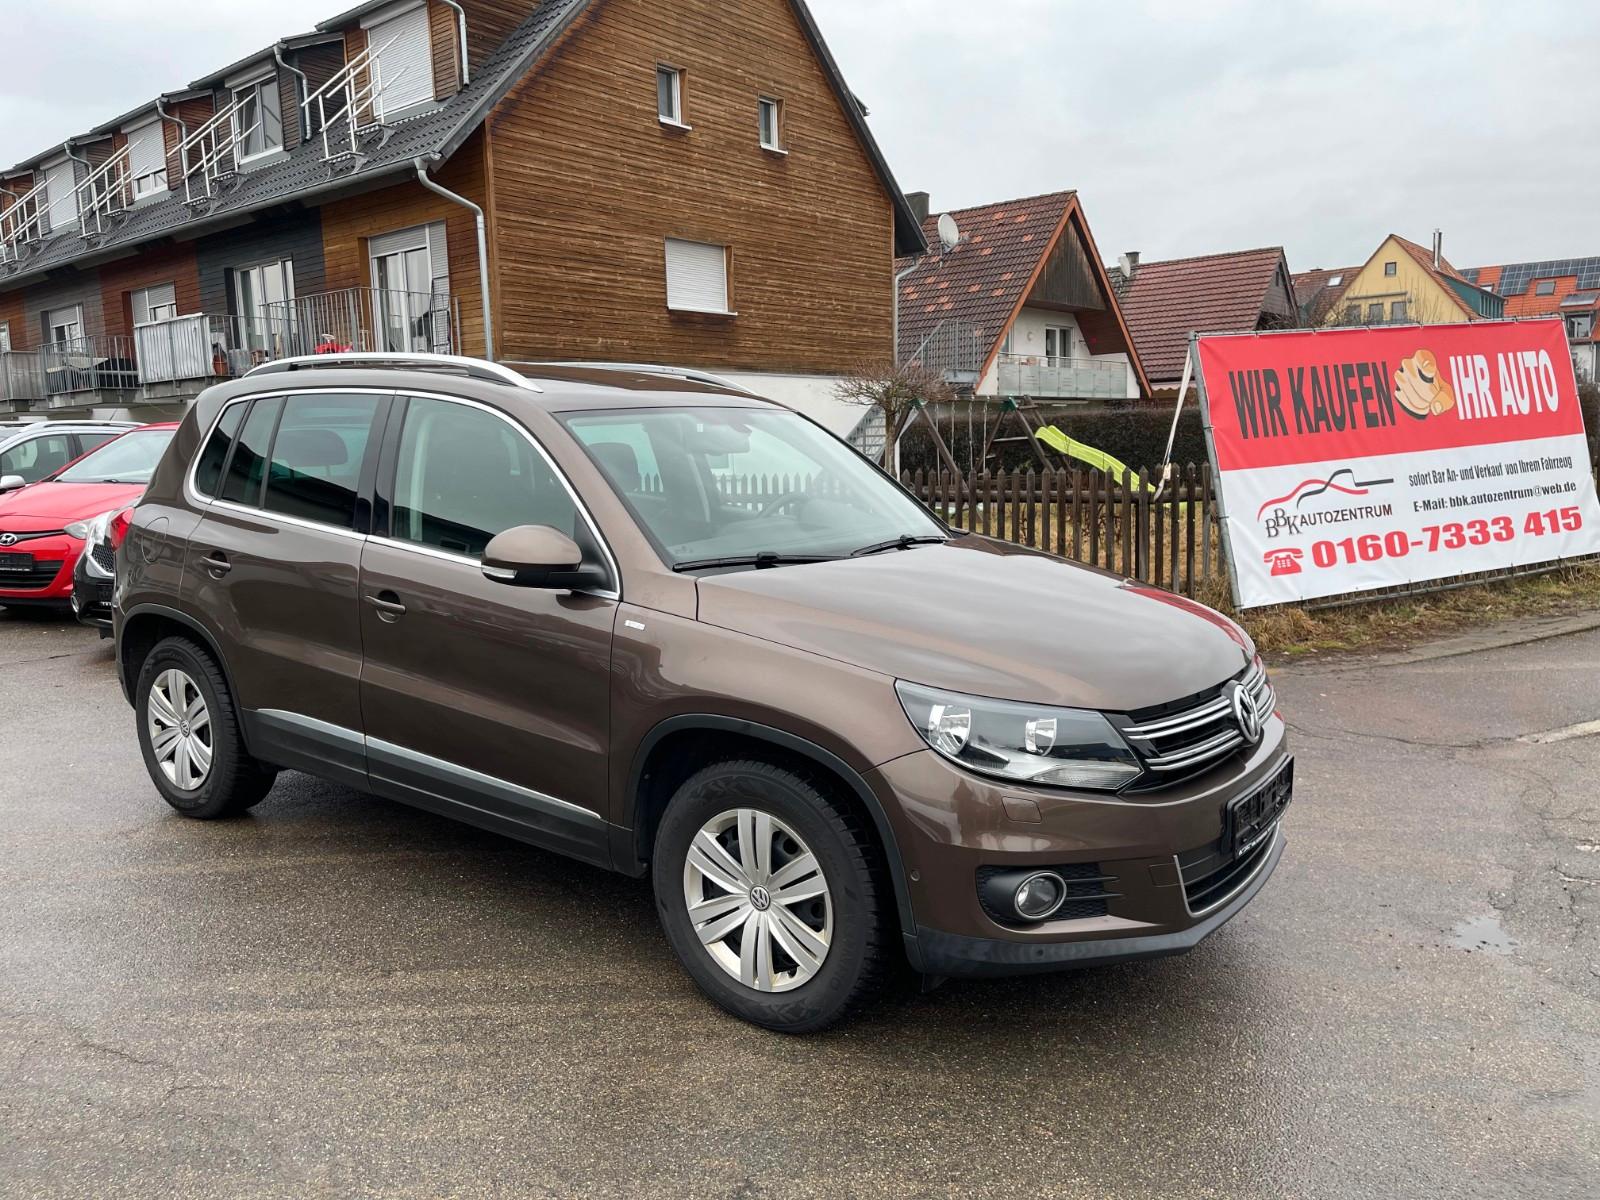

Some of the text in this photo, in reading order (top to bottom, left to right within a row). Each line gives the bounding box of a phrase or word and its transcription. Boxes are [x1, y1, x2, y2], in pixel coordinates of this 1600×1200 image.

[1228, 349, 1559, 439] WIR KAUFEN IHR AUTO
[1408, 456, 1573, 487] sofort Bar An- und Verkauf von Ihrem Fahrzeug
[1413, 481, 1577, 512] E-Mail: bbk.autozentrum@web.de
[1300, 504, 1393, 527] AUTOZENTRUM
[1311, 506, 1583, 568] 0160-7333 415
